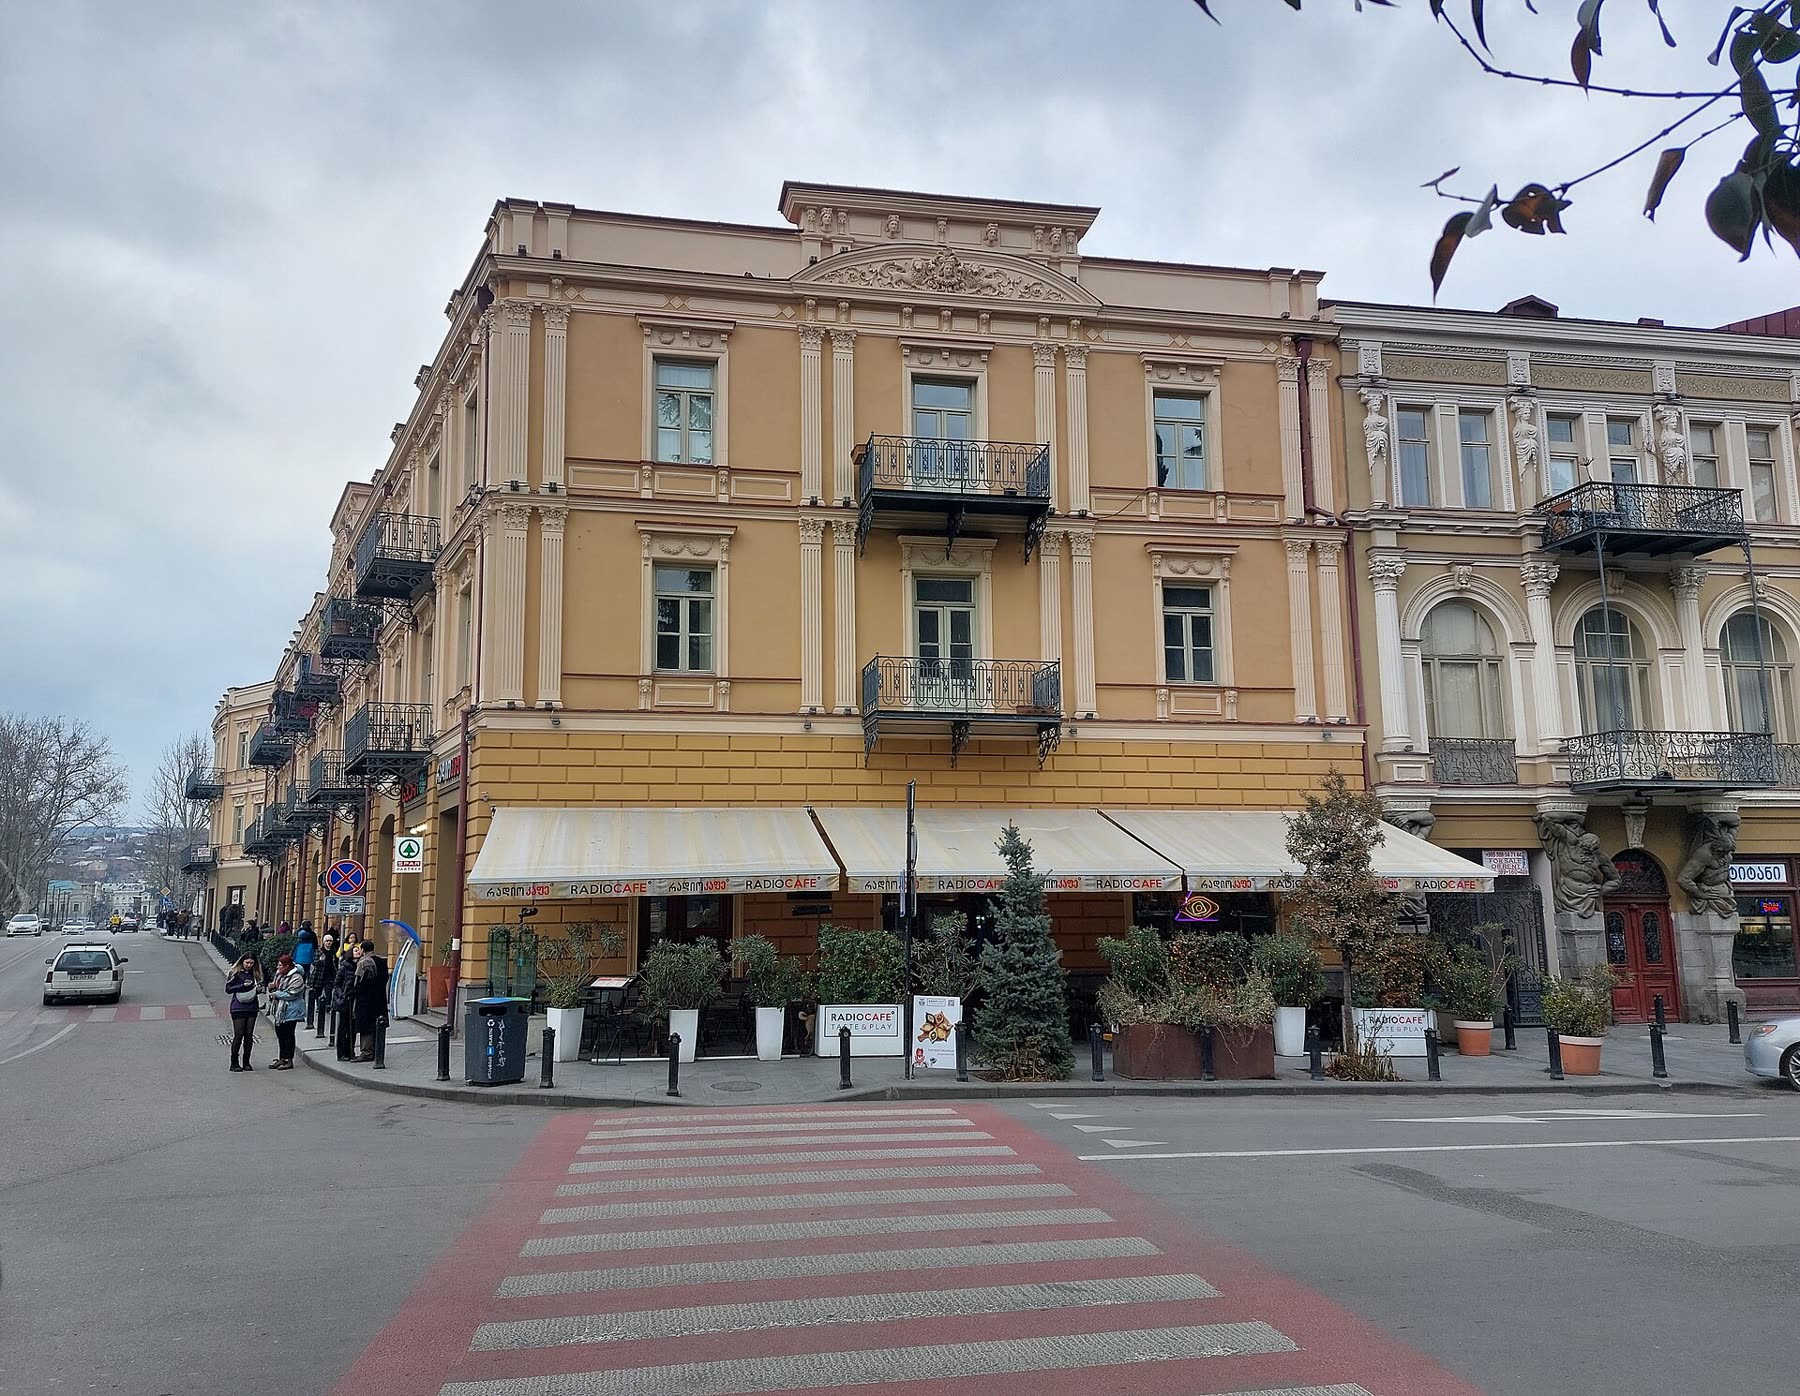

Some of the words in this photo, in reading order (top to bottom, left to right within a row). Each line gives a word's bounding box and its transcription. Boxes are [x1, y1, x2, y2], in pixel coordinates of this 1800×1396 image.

[1729, 866, 1781, 880] ტიტანი
[486, 884, 550, 898] რადიოკაფე
[570, 882, 647, 895] RADIOCAFE
[668, 881, 727, 893] რადიოკაფე
[745, 878, 817, 890] RADIOCAFE
[1096, 879, 1162, 889] RADIOCAFE
[1200, 879, 1252, 889] რადიოკაფე
[1415, 880, 1476, 889] RADIOCAFE
[830, 1012, 892, 1022] RADIOCAFE
[1369, 1015, 1423, 1024] RADIOCAFE
